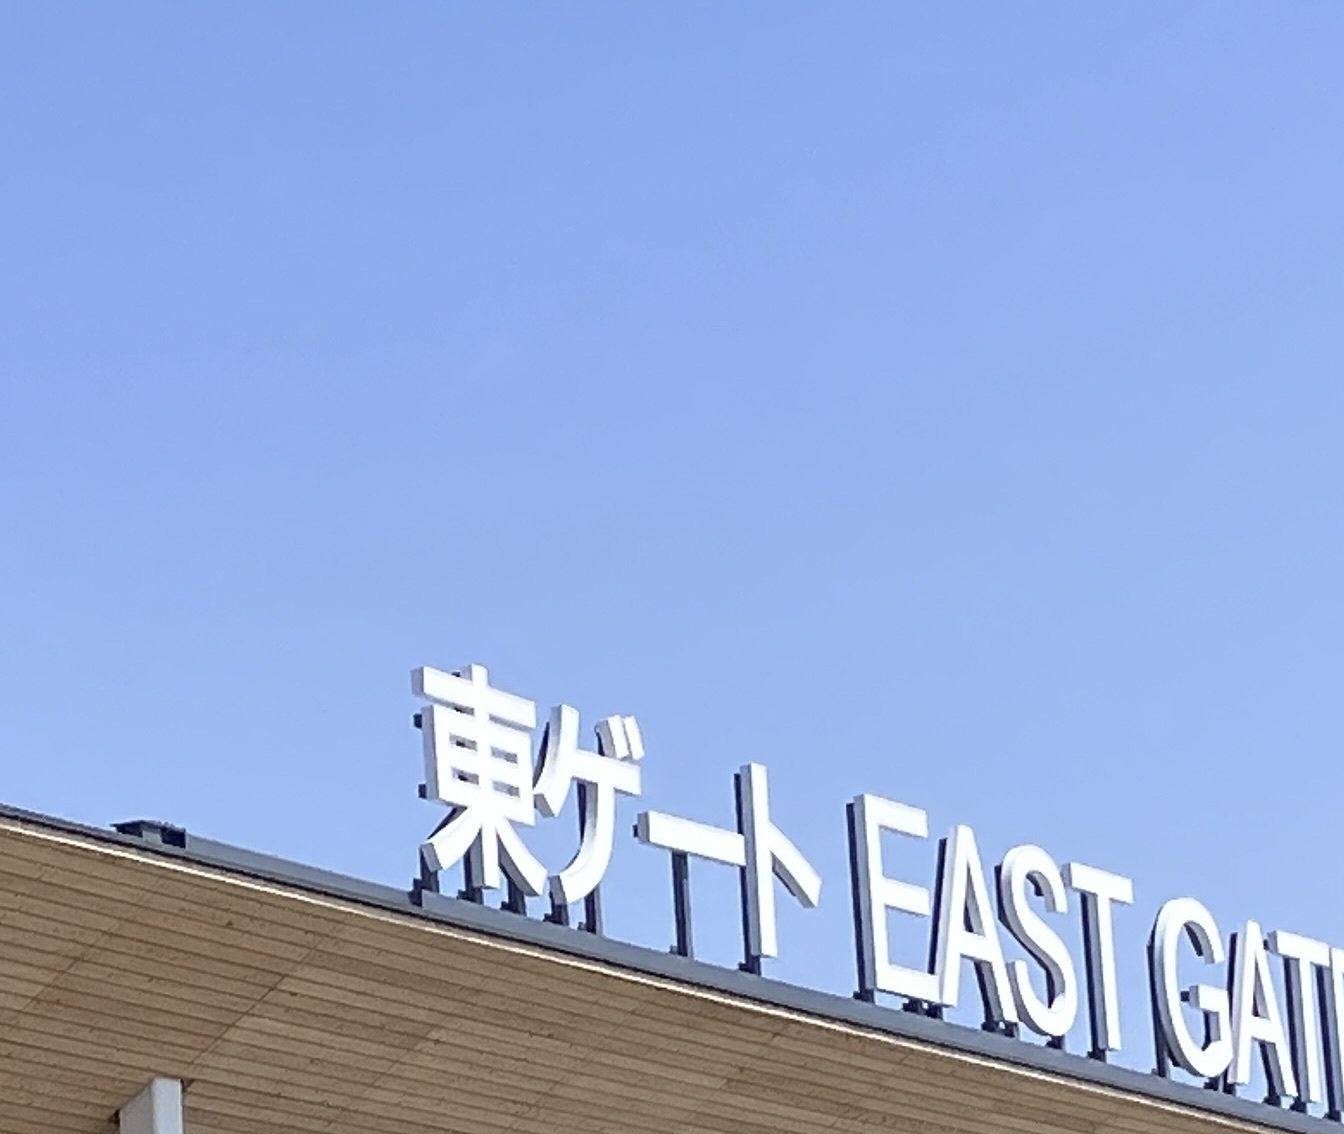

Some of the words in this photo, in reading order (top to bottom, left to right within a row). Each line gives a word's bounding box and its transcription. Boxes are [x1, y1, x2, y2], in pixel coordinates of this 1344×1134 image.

[412, 664, 822, 957] 東ゲート
[849, 793, 1134, 1052] EAST
